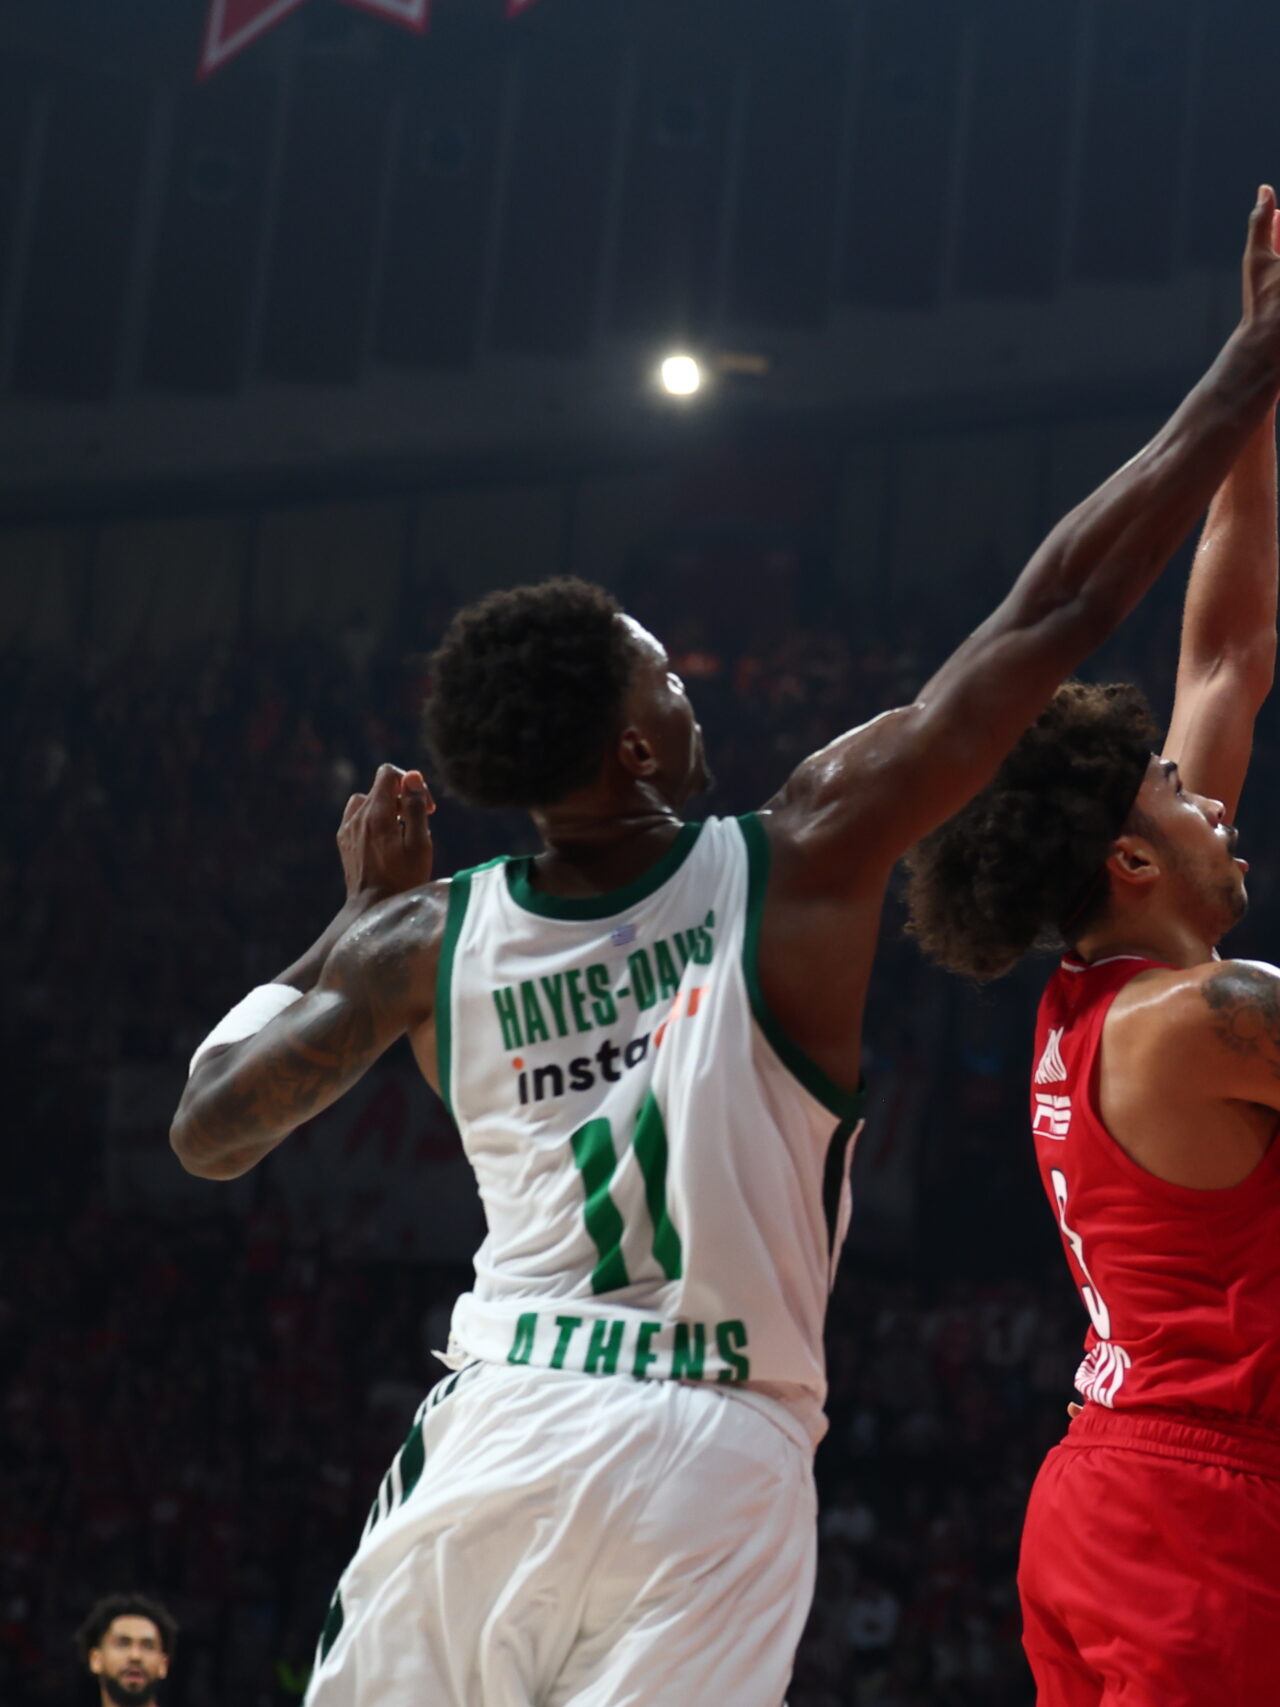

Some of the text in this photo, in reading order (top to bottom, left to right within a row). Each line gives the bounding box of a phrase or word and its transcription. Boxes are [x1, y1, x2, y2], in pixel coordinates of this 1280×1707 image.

[512, 985, 711, 1105] insta
[569, 1087, 684, 1297] 11
[507, 1311, 751, 1384] ATHENS
